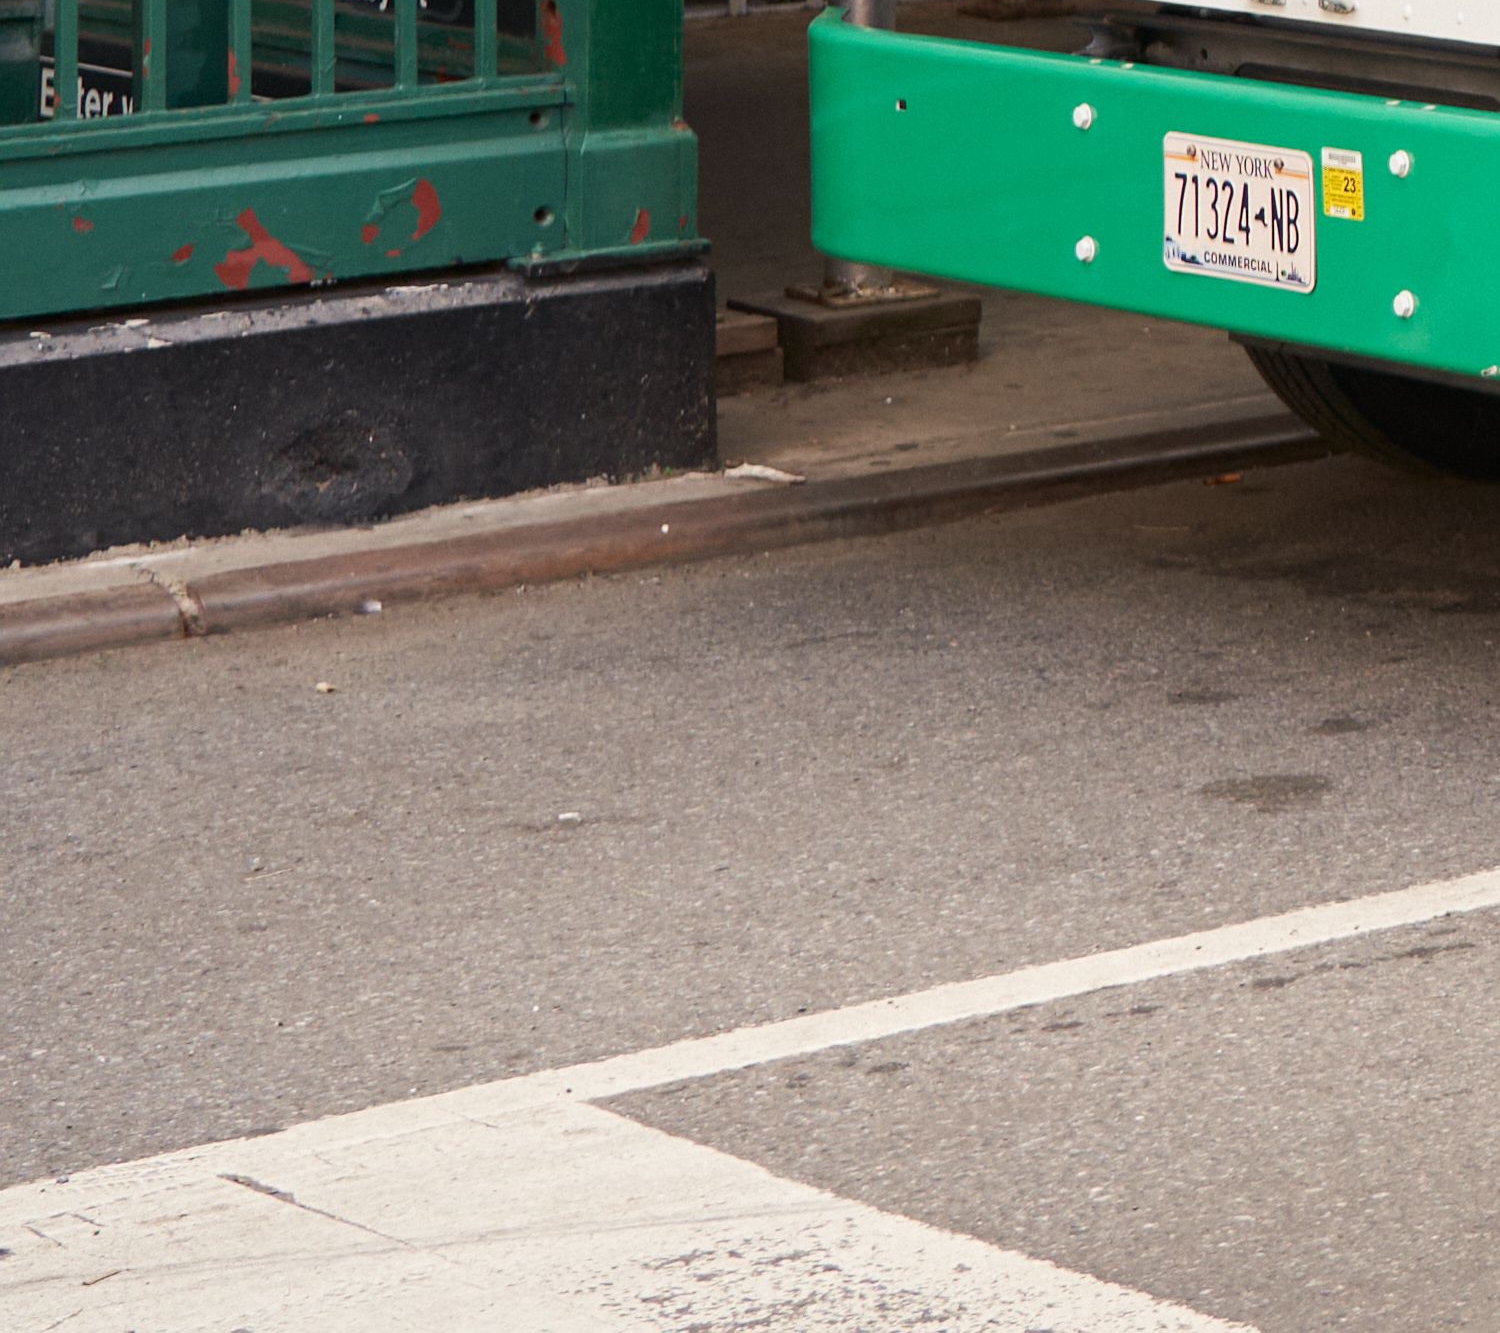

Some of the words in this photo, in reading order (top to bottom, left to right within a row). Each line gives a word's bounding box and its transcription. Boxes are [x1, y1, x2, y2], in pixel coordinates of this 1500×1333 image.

[40, 67, 113, 120] Eter
[1200, 149, 1232, 173] NEW
[1236, 155, 1274, 180] YORK
[1343, 176, 1357, 194] 23
[1203, 250, 1273, 275] COMMERCIAL
